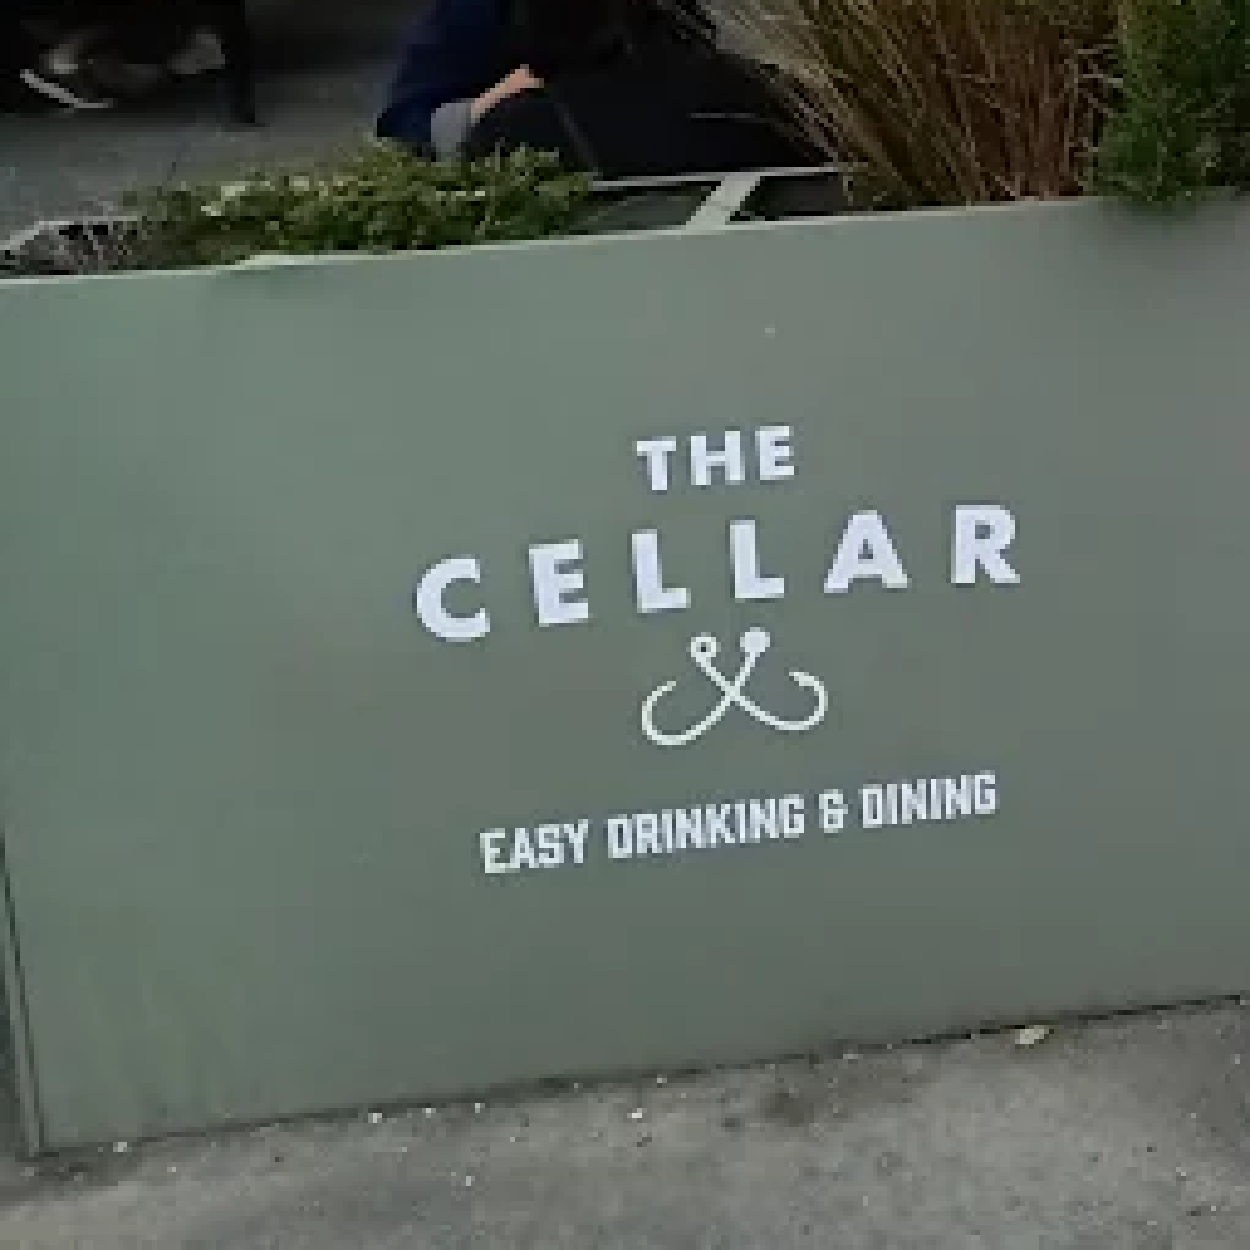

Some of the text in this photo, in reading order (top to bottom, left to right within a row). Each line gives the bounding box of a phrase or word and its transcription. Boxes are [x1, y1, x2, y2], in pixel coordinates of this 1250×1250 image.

[636, 425, 795, 491] THE
[415, 504, 1020, 642] CELLAR
[479, 771, 998, 874] EASY DRINKING & DINING
